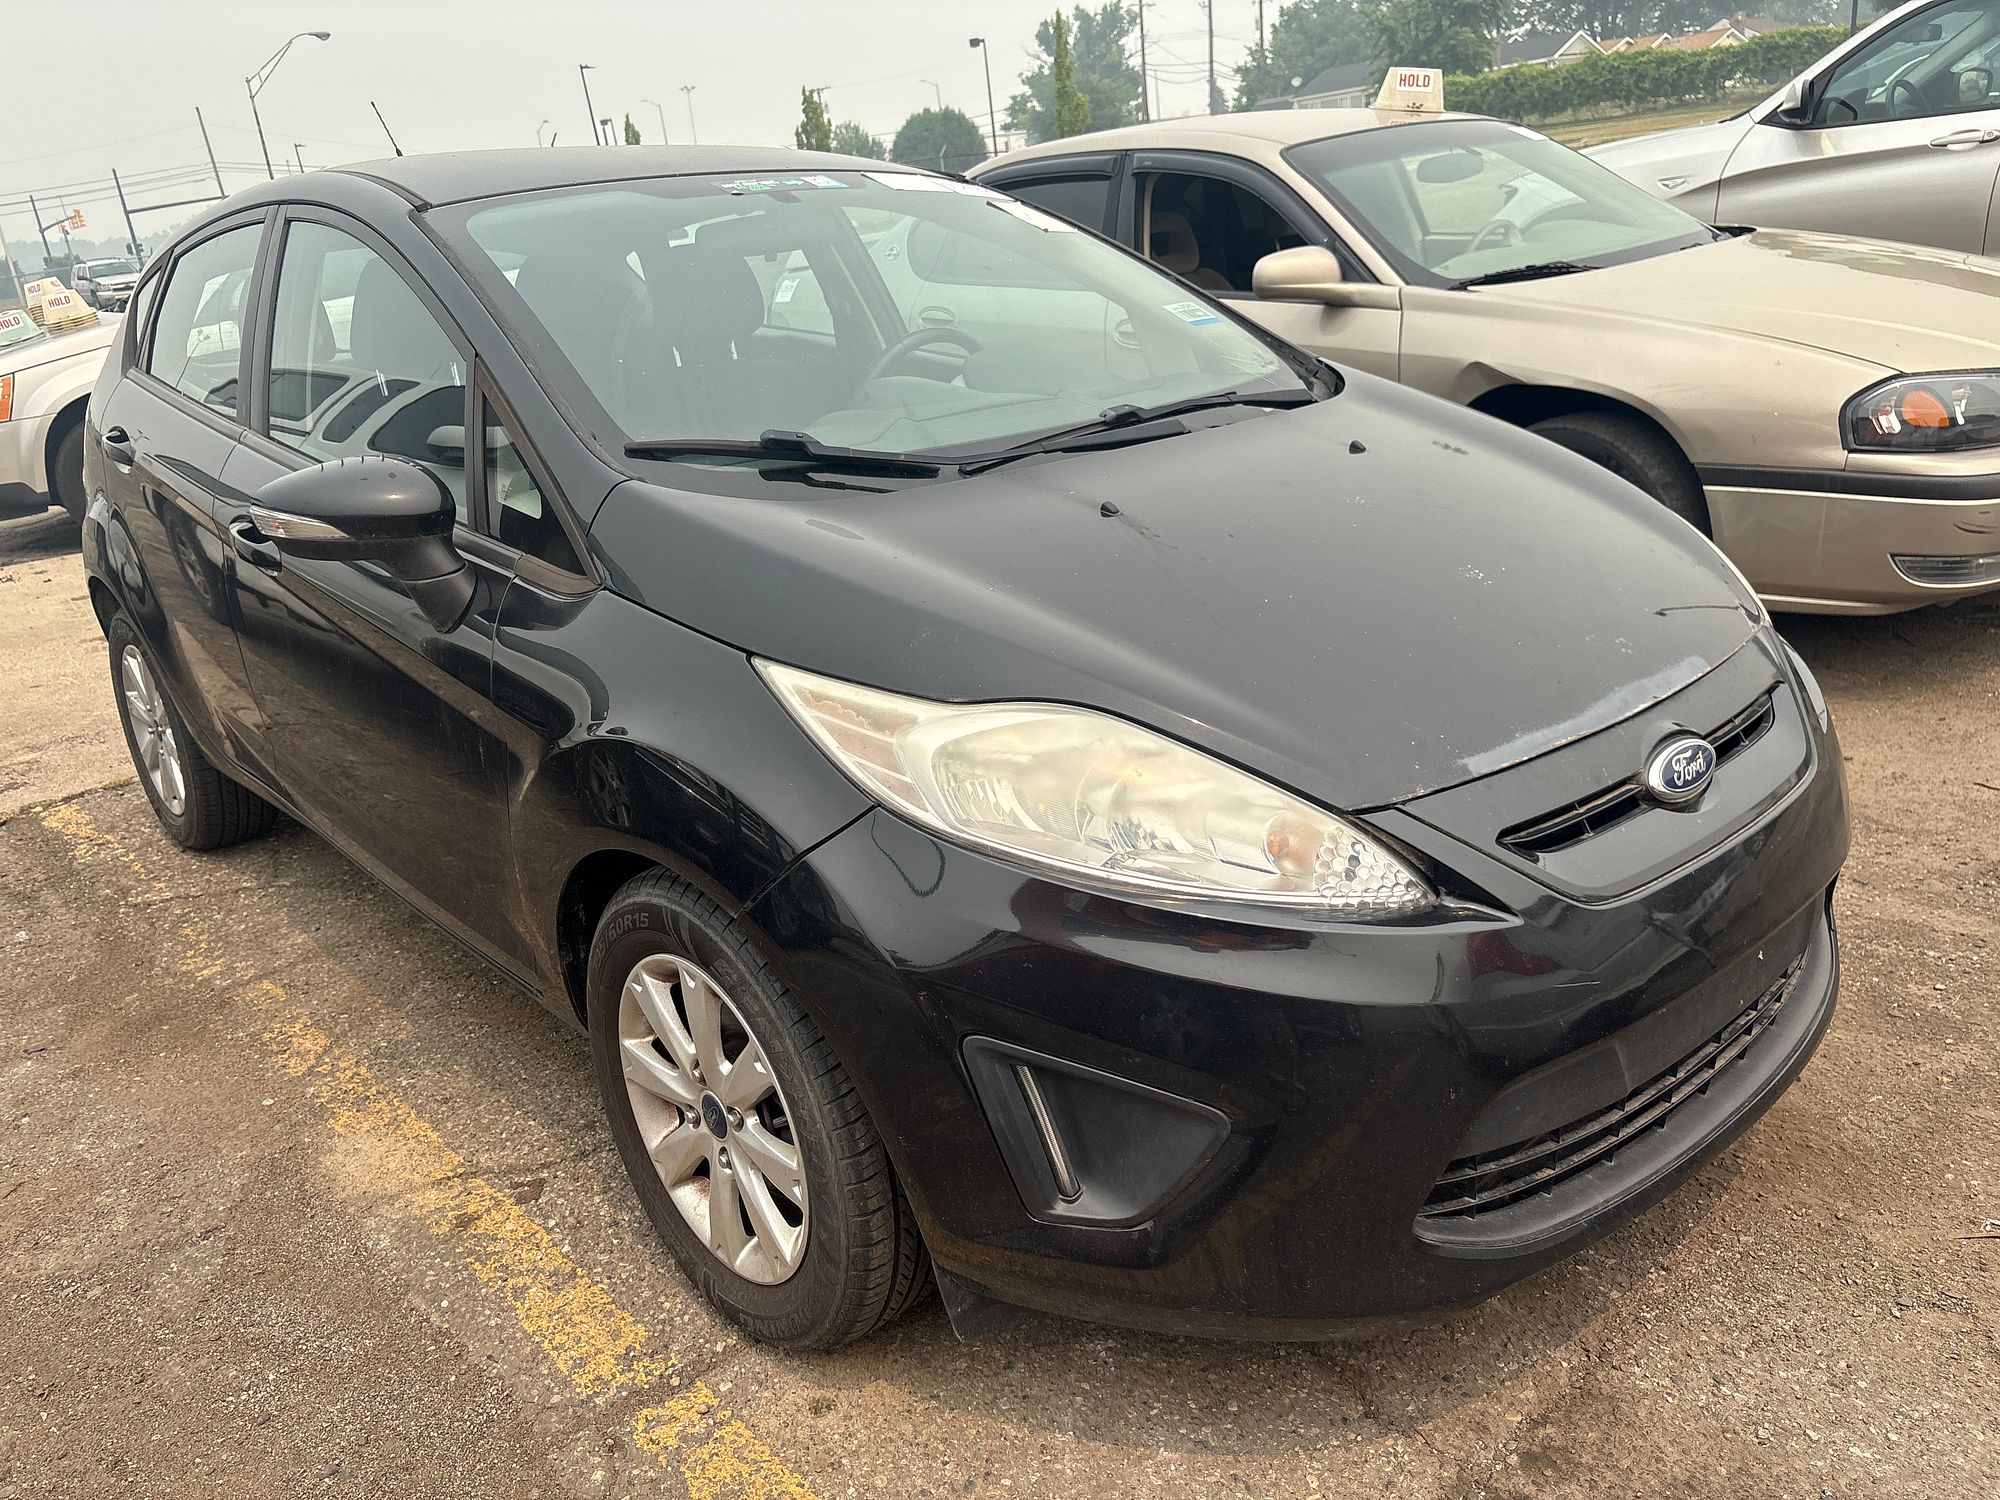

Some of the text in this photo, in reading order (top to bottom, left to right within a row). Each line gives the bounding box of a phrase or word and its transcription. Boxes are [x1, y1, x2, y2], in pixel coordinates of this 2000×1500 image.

[1399, 73, 1431, 88] HOLD
[28, 284, 41, 294] HOLD
[48, 296, 71, 308] HOLD
[1672, 749, 1706, 786] Ford
